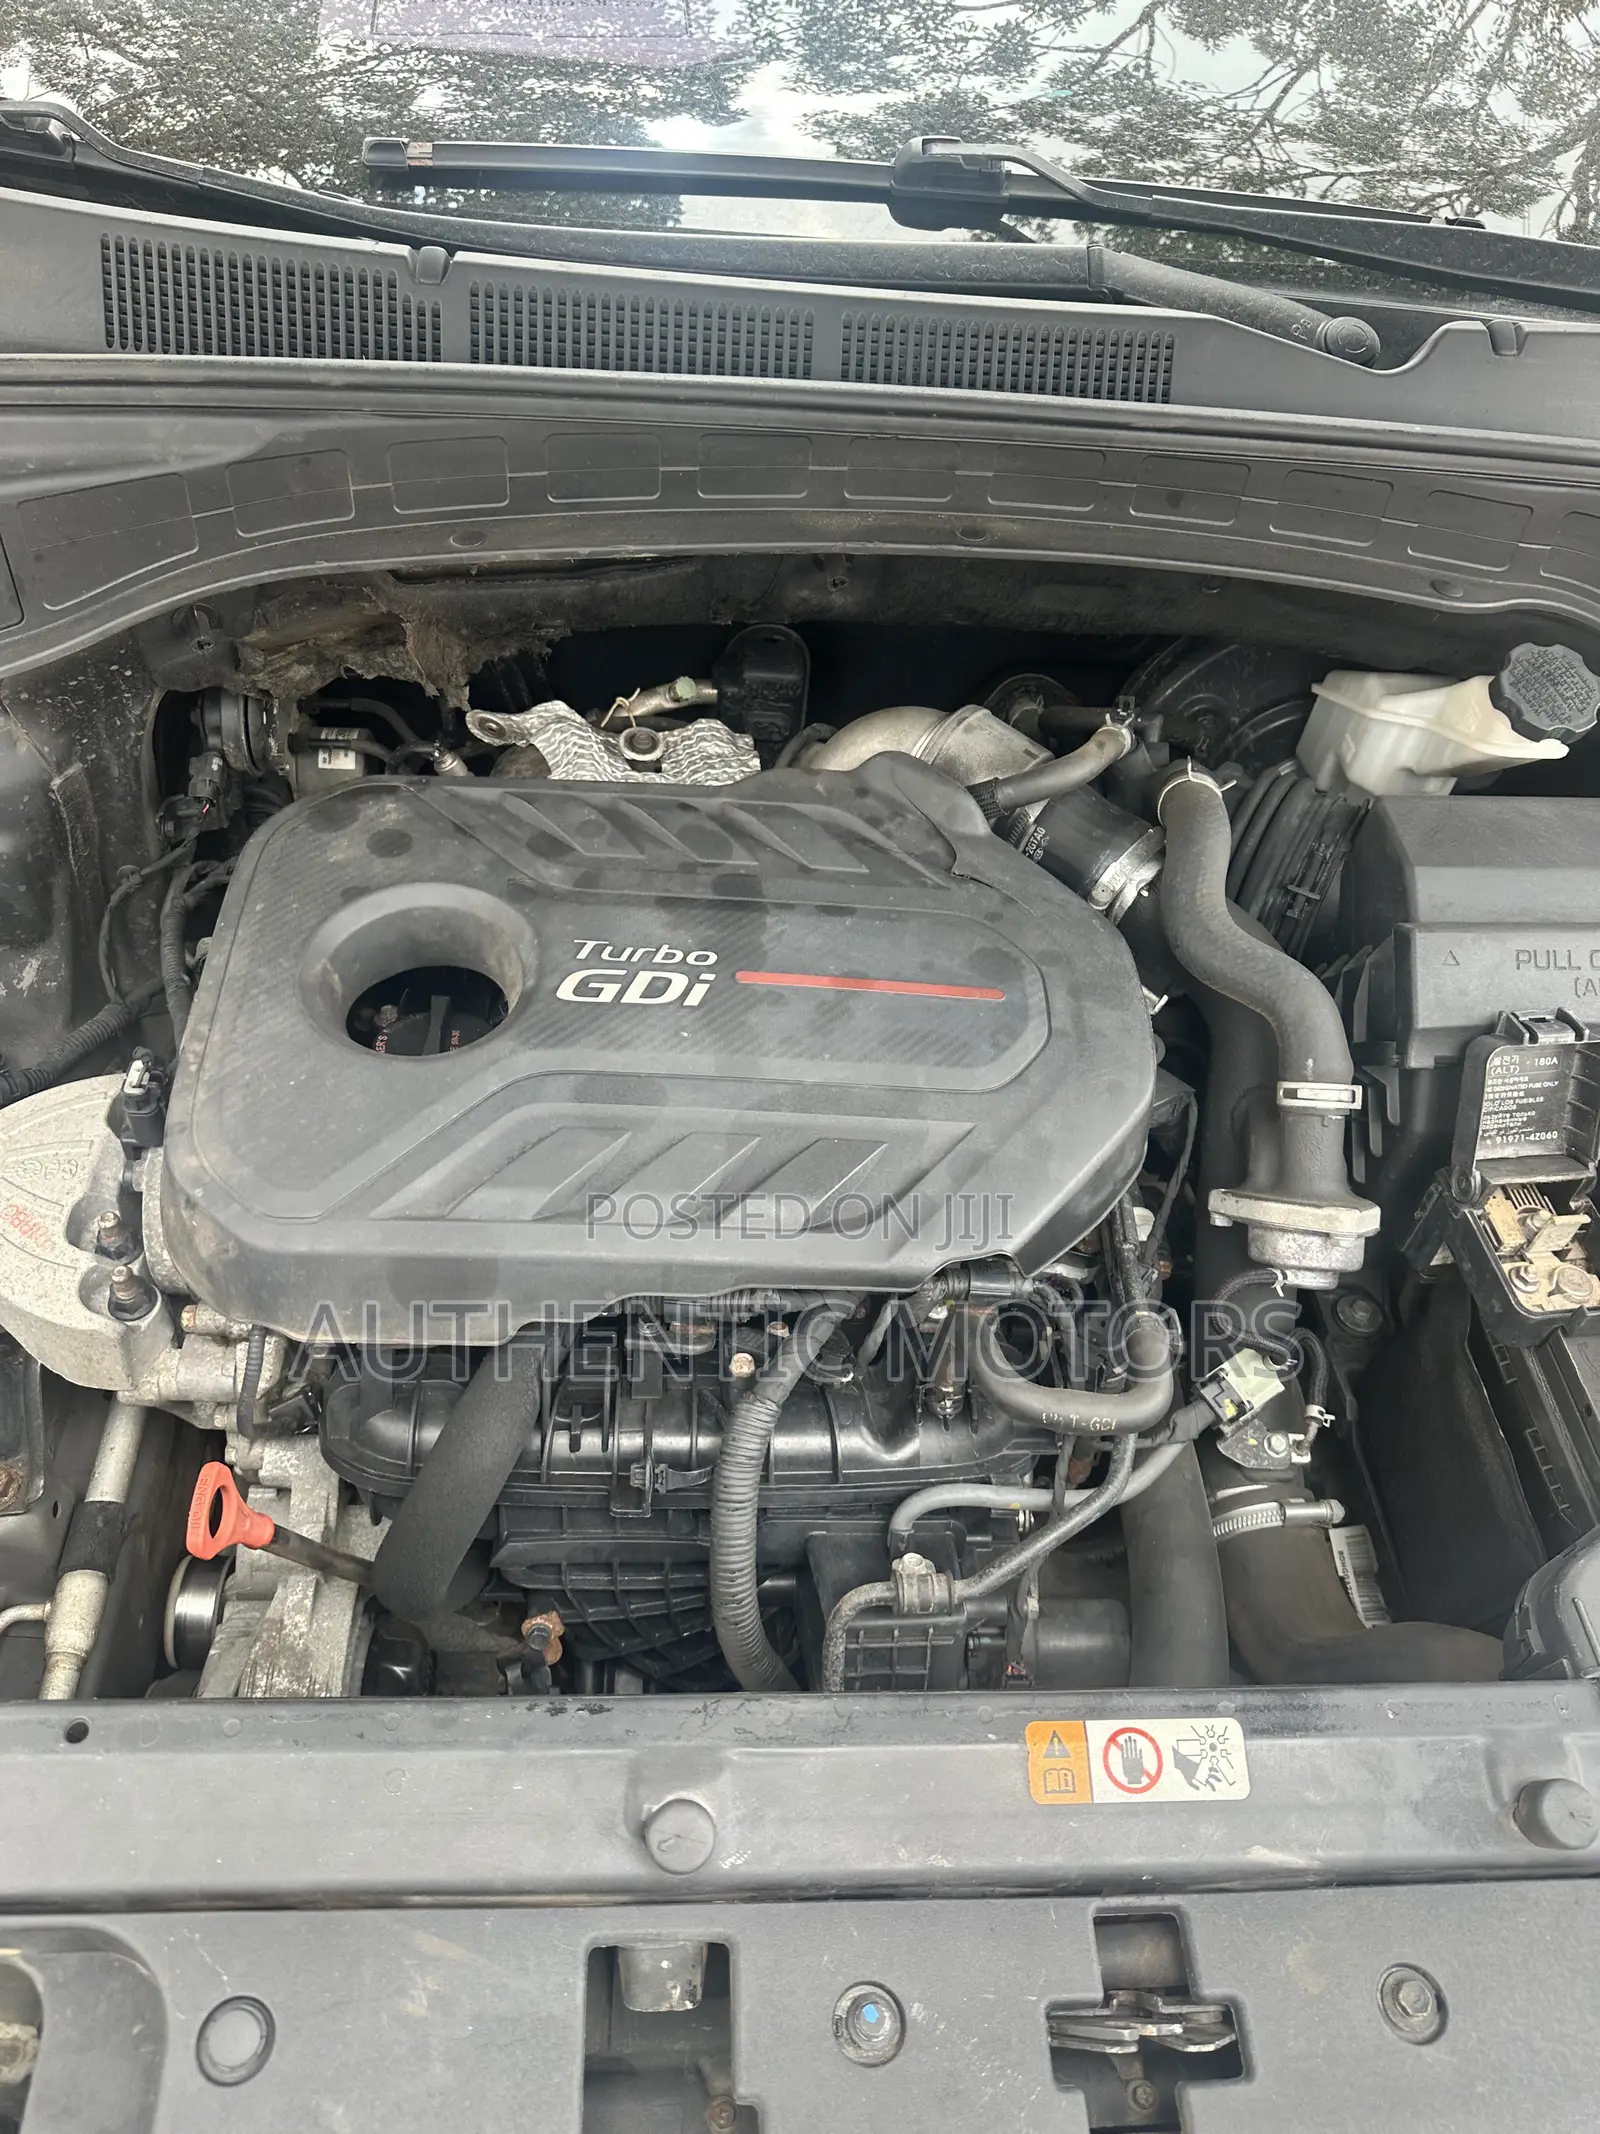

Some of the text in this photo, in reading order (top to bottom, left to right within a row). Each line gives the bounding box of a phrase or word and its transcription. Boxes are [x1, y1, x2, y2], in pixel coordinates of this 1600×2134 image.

[573, 939, 719, 966] Turbo
[1515, 949, 1581, 970] PULL
[555, 968, 717, 1007] GDi
[1534, 1056, 1558, 1066] 180A
[1490, 1065, 1520, 1076] (ALT)
[1542, 1080, 1559, 1088] ONLY
[1515, 1096, 1544, 1104] FUSIBLES
[1496, 1130, 1558, 1144] 91971-4Z060
[195, 1477, 209, 1504] ENG
